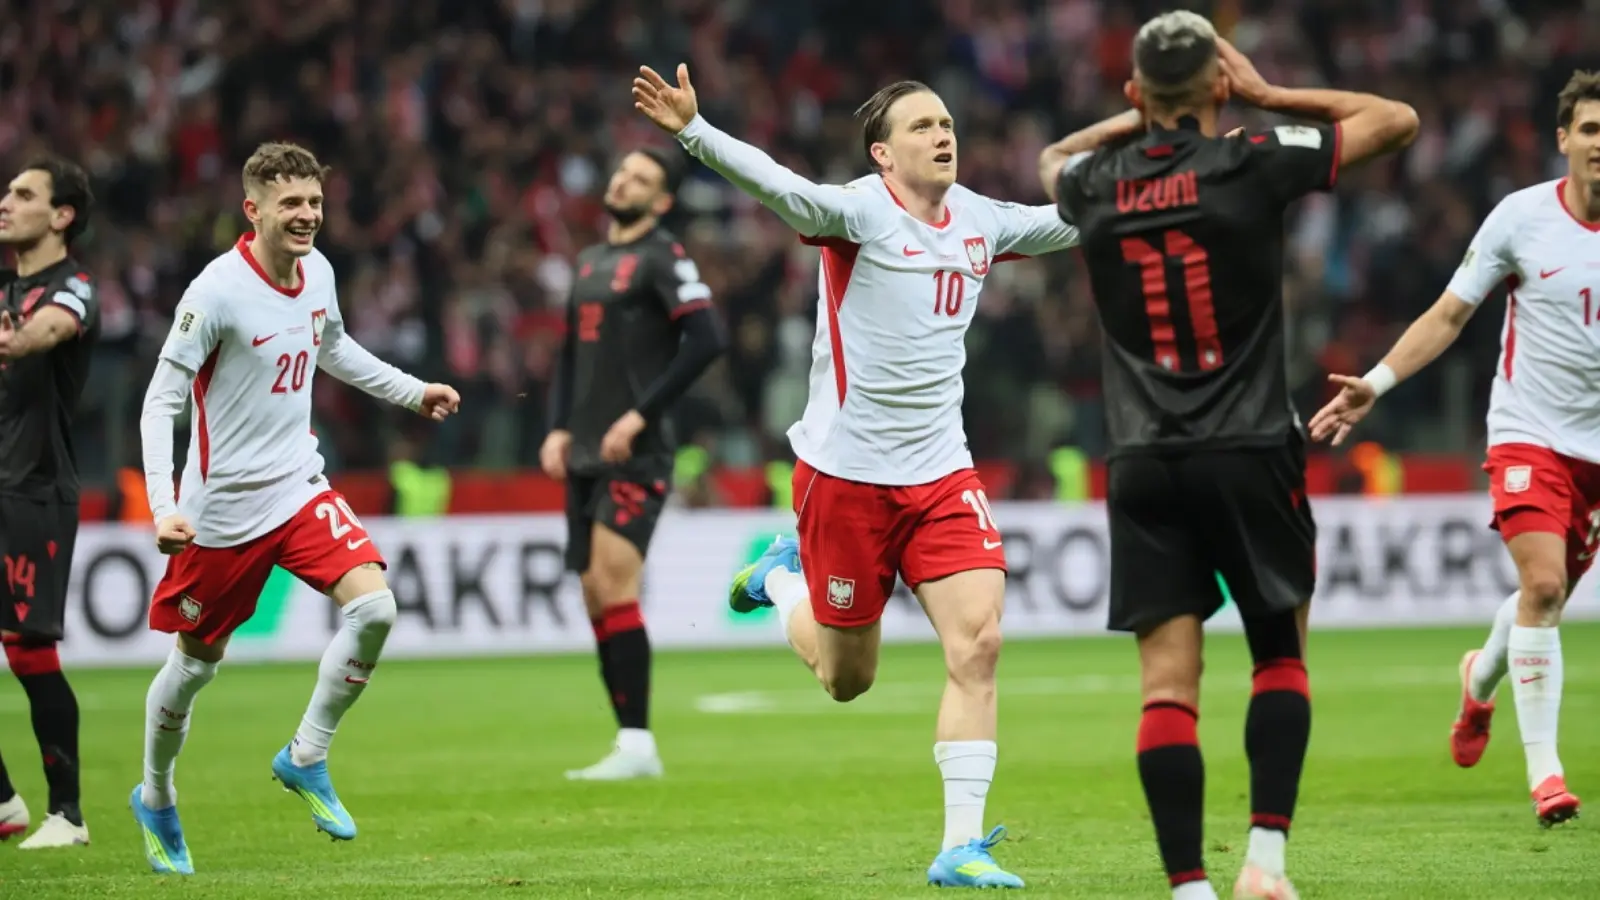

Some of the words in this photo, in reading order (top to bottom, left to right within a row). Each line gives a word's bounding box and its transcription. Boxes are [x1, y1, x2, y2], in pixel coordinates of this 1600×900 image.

[1116, 170, 1198, 213] UZUNI
[933, 269, 964, 317] 10
[1120, 230, 1224, 373] 11
[1578, 287, 1600, 327] 1
[271, 351, 309, 394] 20
[4, 554, 36, 598] 14
[1316, 520, 1518, 598] AKR
[327, 539, 568, 631] AKR
